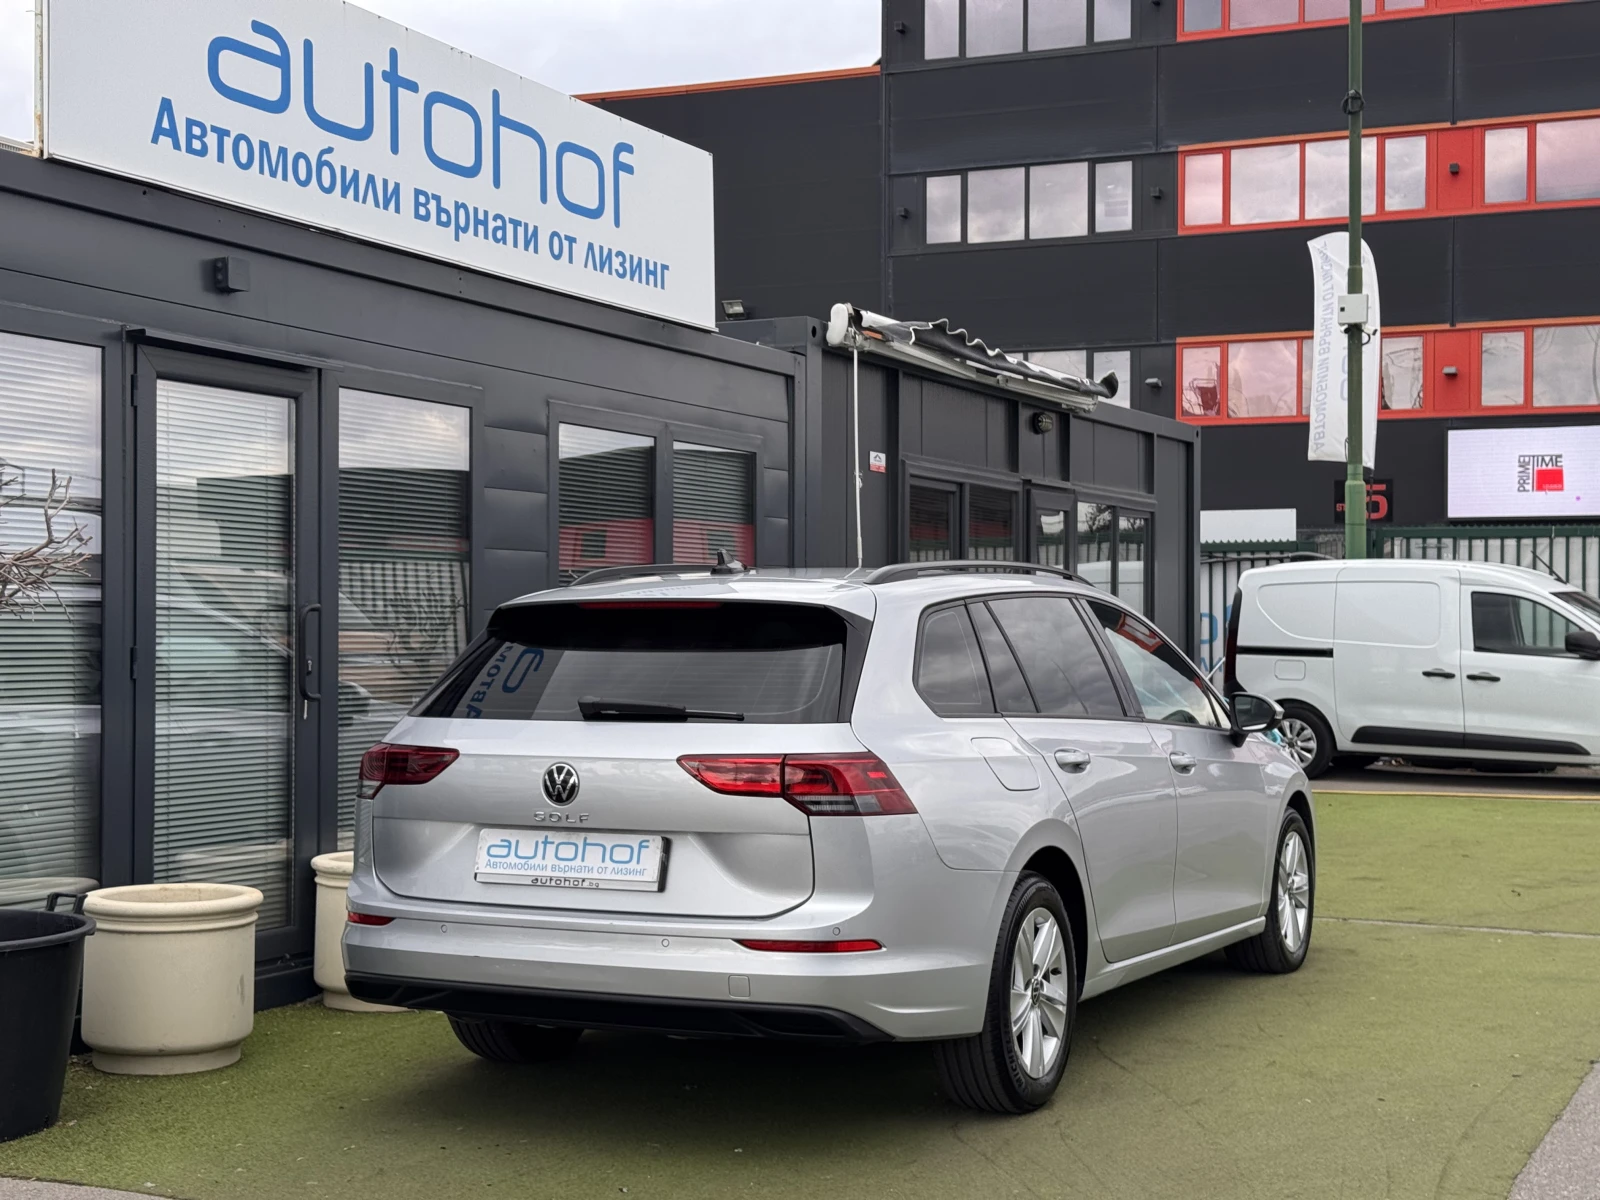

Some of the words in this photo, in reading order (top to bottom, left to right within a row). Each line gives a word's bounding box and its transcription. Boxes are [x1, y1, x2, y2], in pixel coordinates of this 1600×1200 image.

[207, 19, 635, 228] autohof
[151, 97, 401, 214] Автомобили
[413, 188, 539, 254] върнати
[549, 231, 577, 264] от
[583, 242, 669, 289] лизинг
[1517, 455, 1530, 492] PRIME
[533, 811, 589, 823] GOLF
[486, 834, 650, 865] autohof
[485, 858, 548, 872] Автомобили
[550, 863, 594, 875] върнати
[597, 866, 609, 875] от
[610, 867, 648, 877] лизинг
[531, 876, 600, 888] autohof.bg
